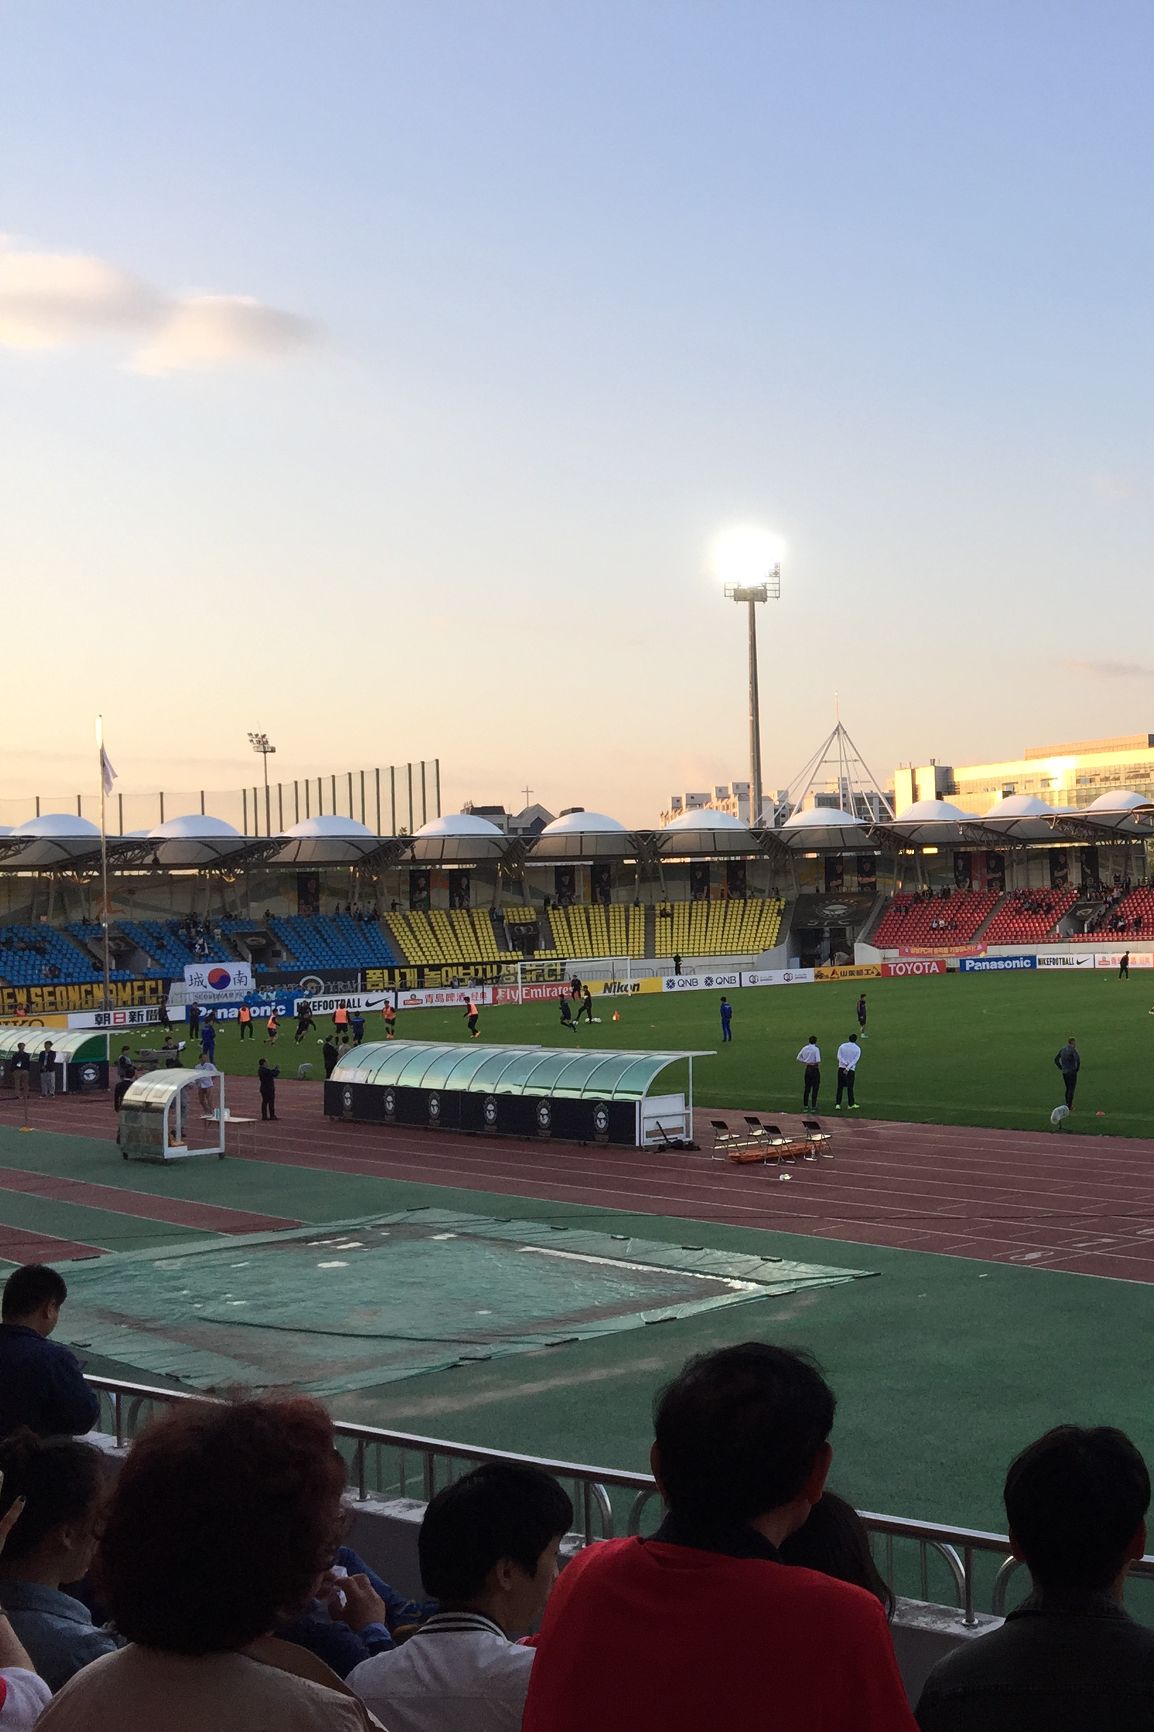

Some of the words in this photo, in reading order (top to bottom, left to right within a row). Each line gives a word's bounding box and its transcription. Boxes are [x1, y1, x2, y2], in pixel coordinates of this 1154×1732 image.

[888, 961, 940, 976] TOYOTA
[965, 958, 1032, 971] Panasonic
[188, 971, 207, 990] 城
[233, 969, 248, 987] 南
[677, 978, 699, 988] QNB
[715, 976, 737, 986] QNB
[602, 981, 641, 994] Nikon
[0, 987, 27, 1015] EW
[296, 998, 362, 1013] NEFOOTALL
[196, 1002, 287, 1020] Pnaonc
